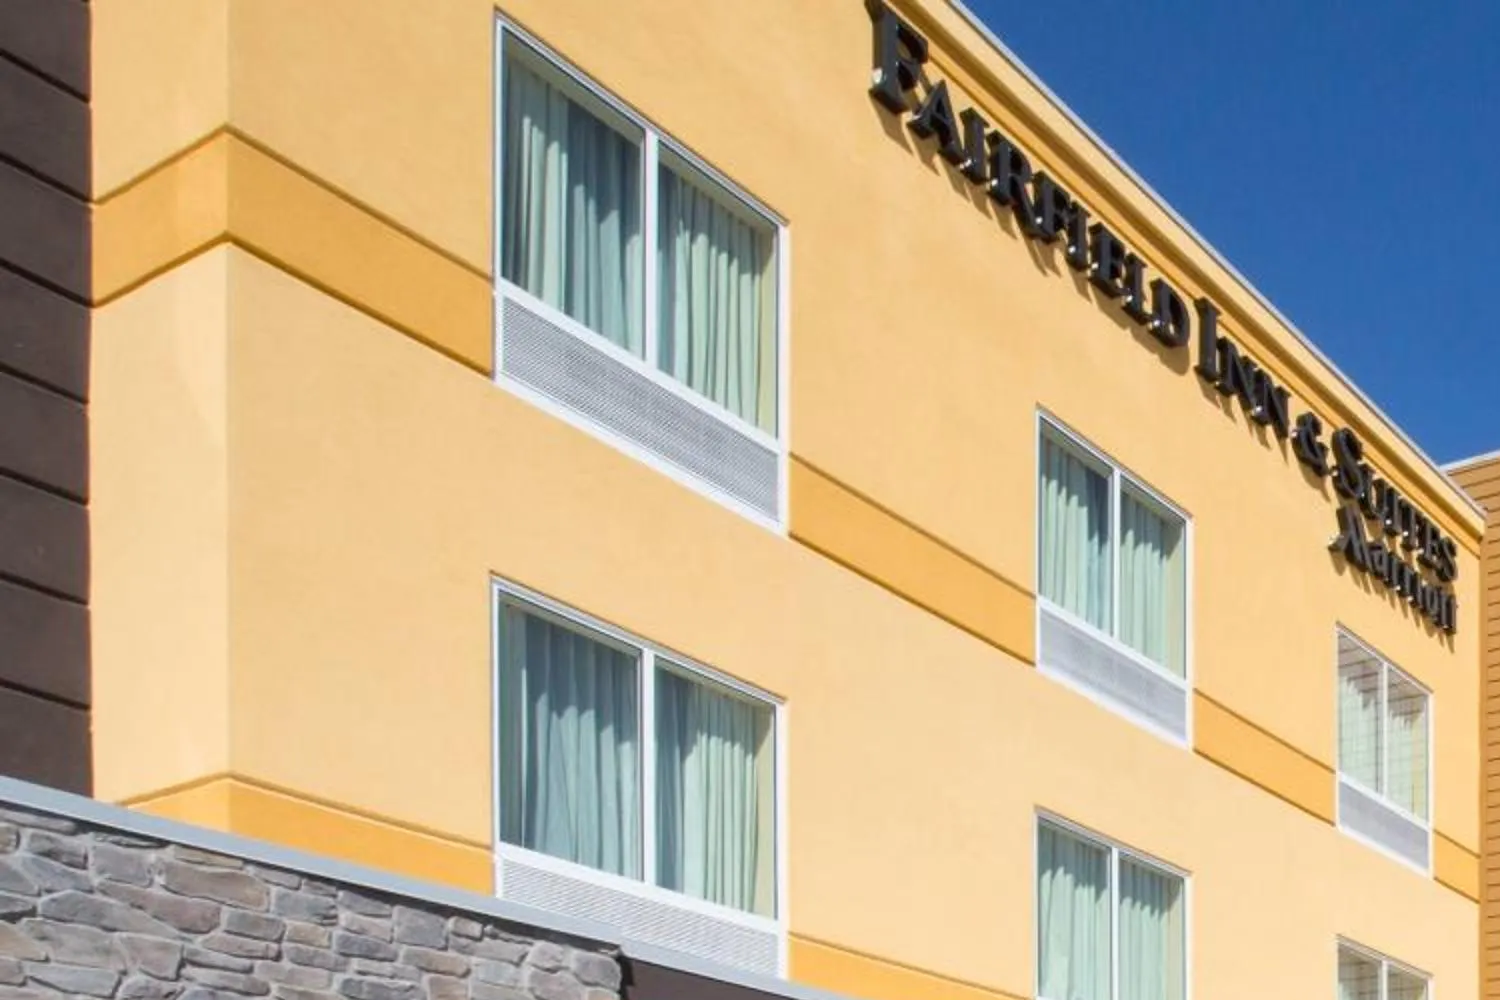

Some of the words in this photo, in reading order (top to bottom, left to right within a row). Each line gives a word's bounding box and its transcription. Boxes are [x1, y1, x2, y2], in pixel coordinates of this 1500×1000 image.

[864, 0, 1191, 347] FAIRFIELD
[1193, 297, 1292, 438] INN
[1291, 411, 1329, 477] &
[1329, 427, 1458, 583] SUITES
[1328, 503, 1457, 635] Marriott
